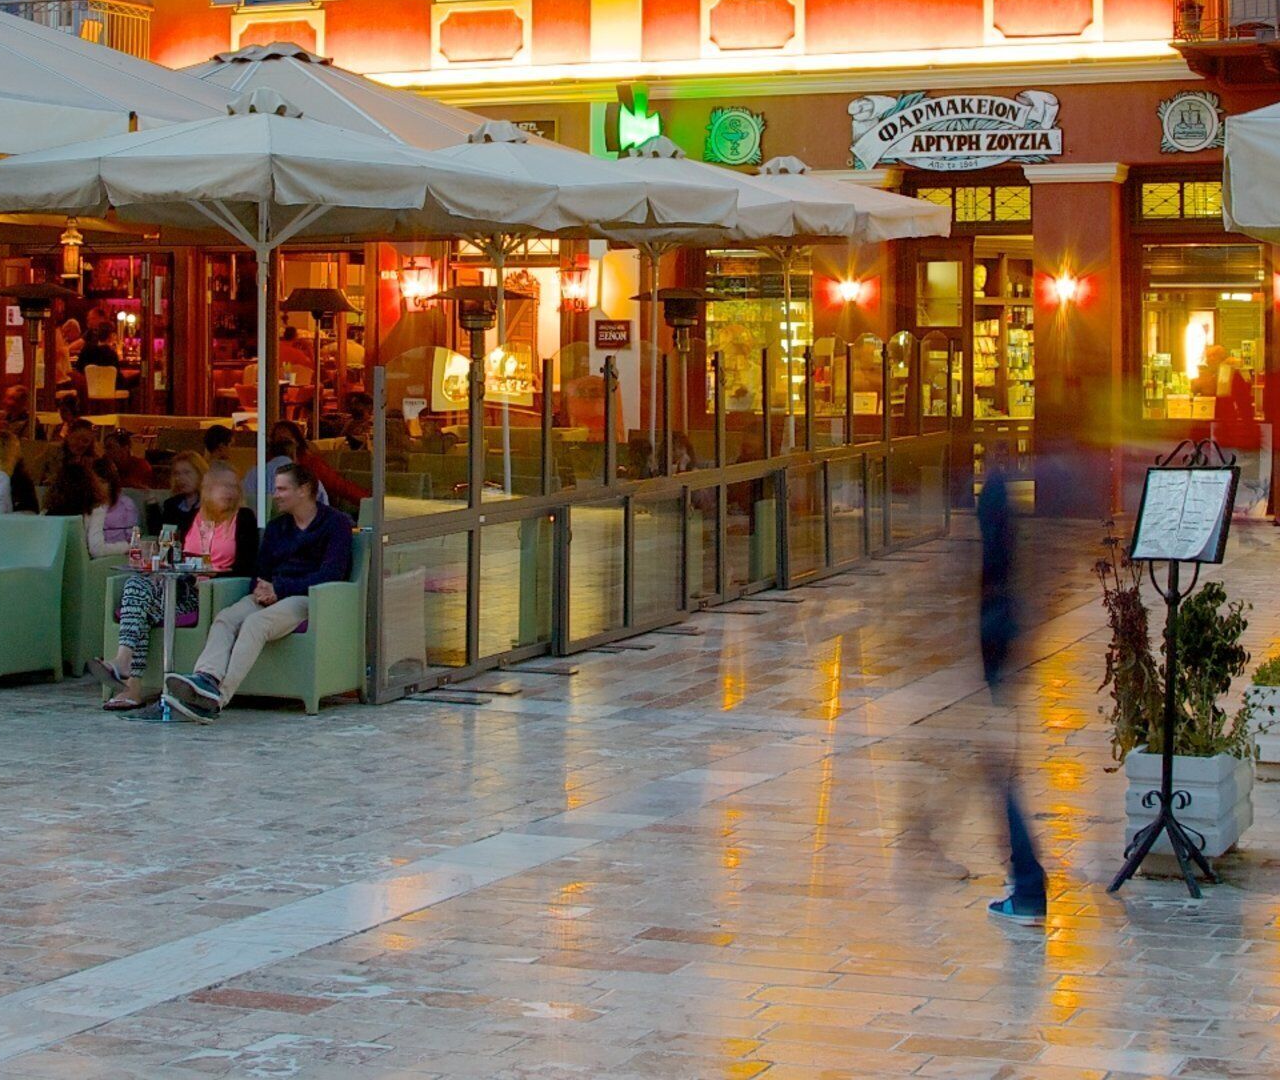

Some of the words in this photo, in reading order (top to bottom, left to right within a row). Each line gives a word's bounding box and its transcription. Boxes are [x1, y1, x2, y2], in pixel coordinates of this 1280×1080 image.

[878, 97, 1020, 143] ΦΑΡΜΑΚΕΙΟΝ
[911, 133, 981, 153] ΑΡΓΥΡΗ
[986, 132, 1052, 151] ΖΟΥΖΙΑ
